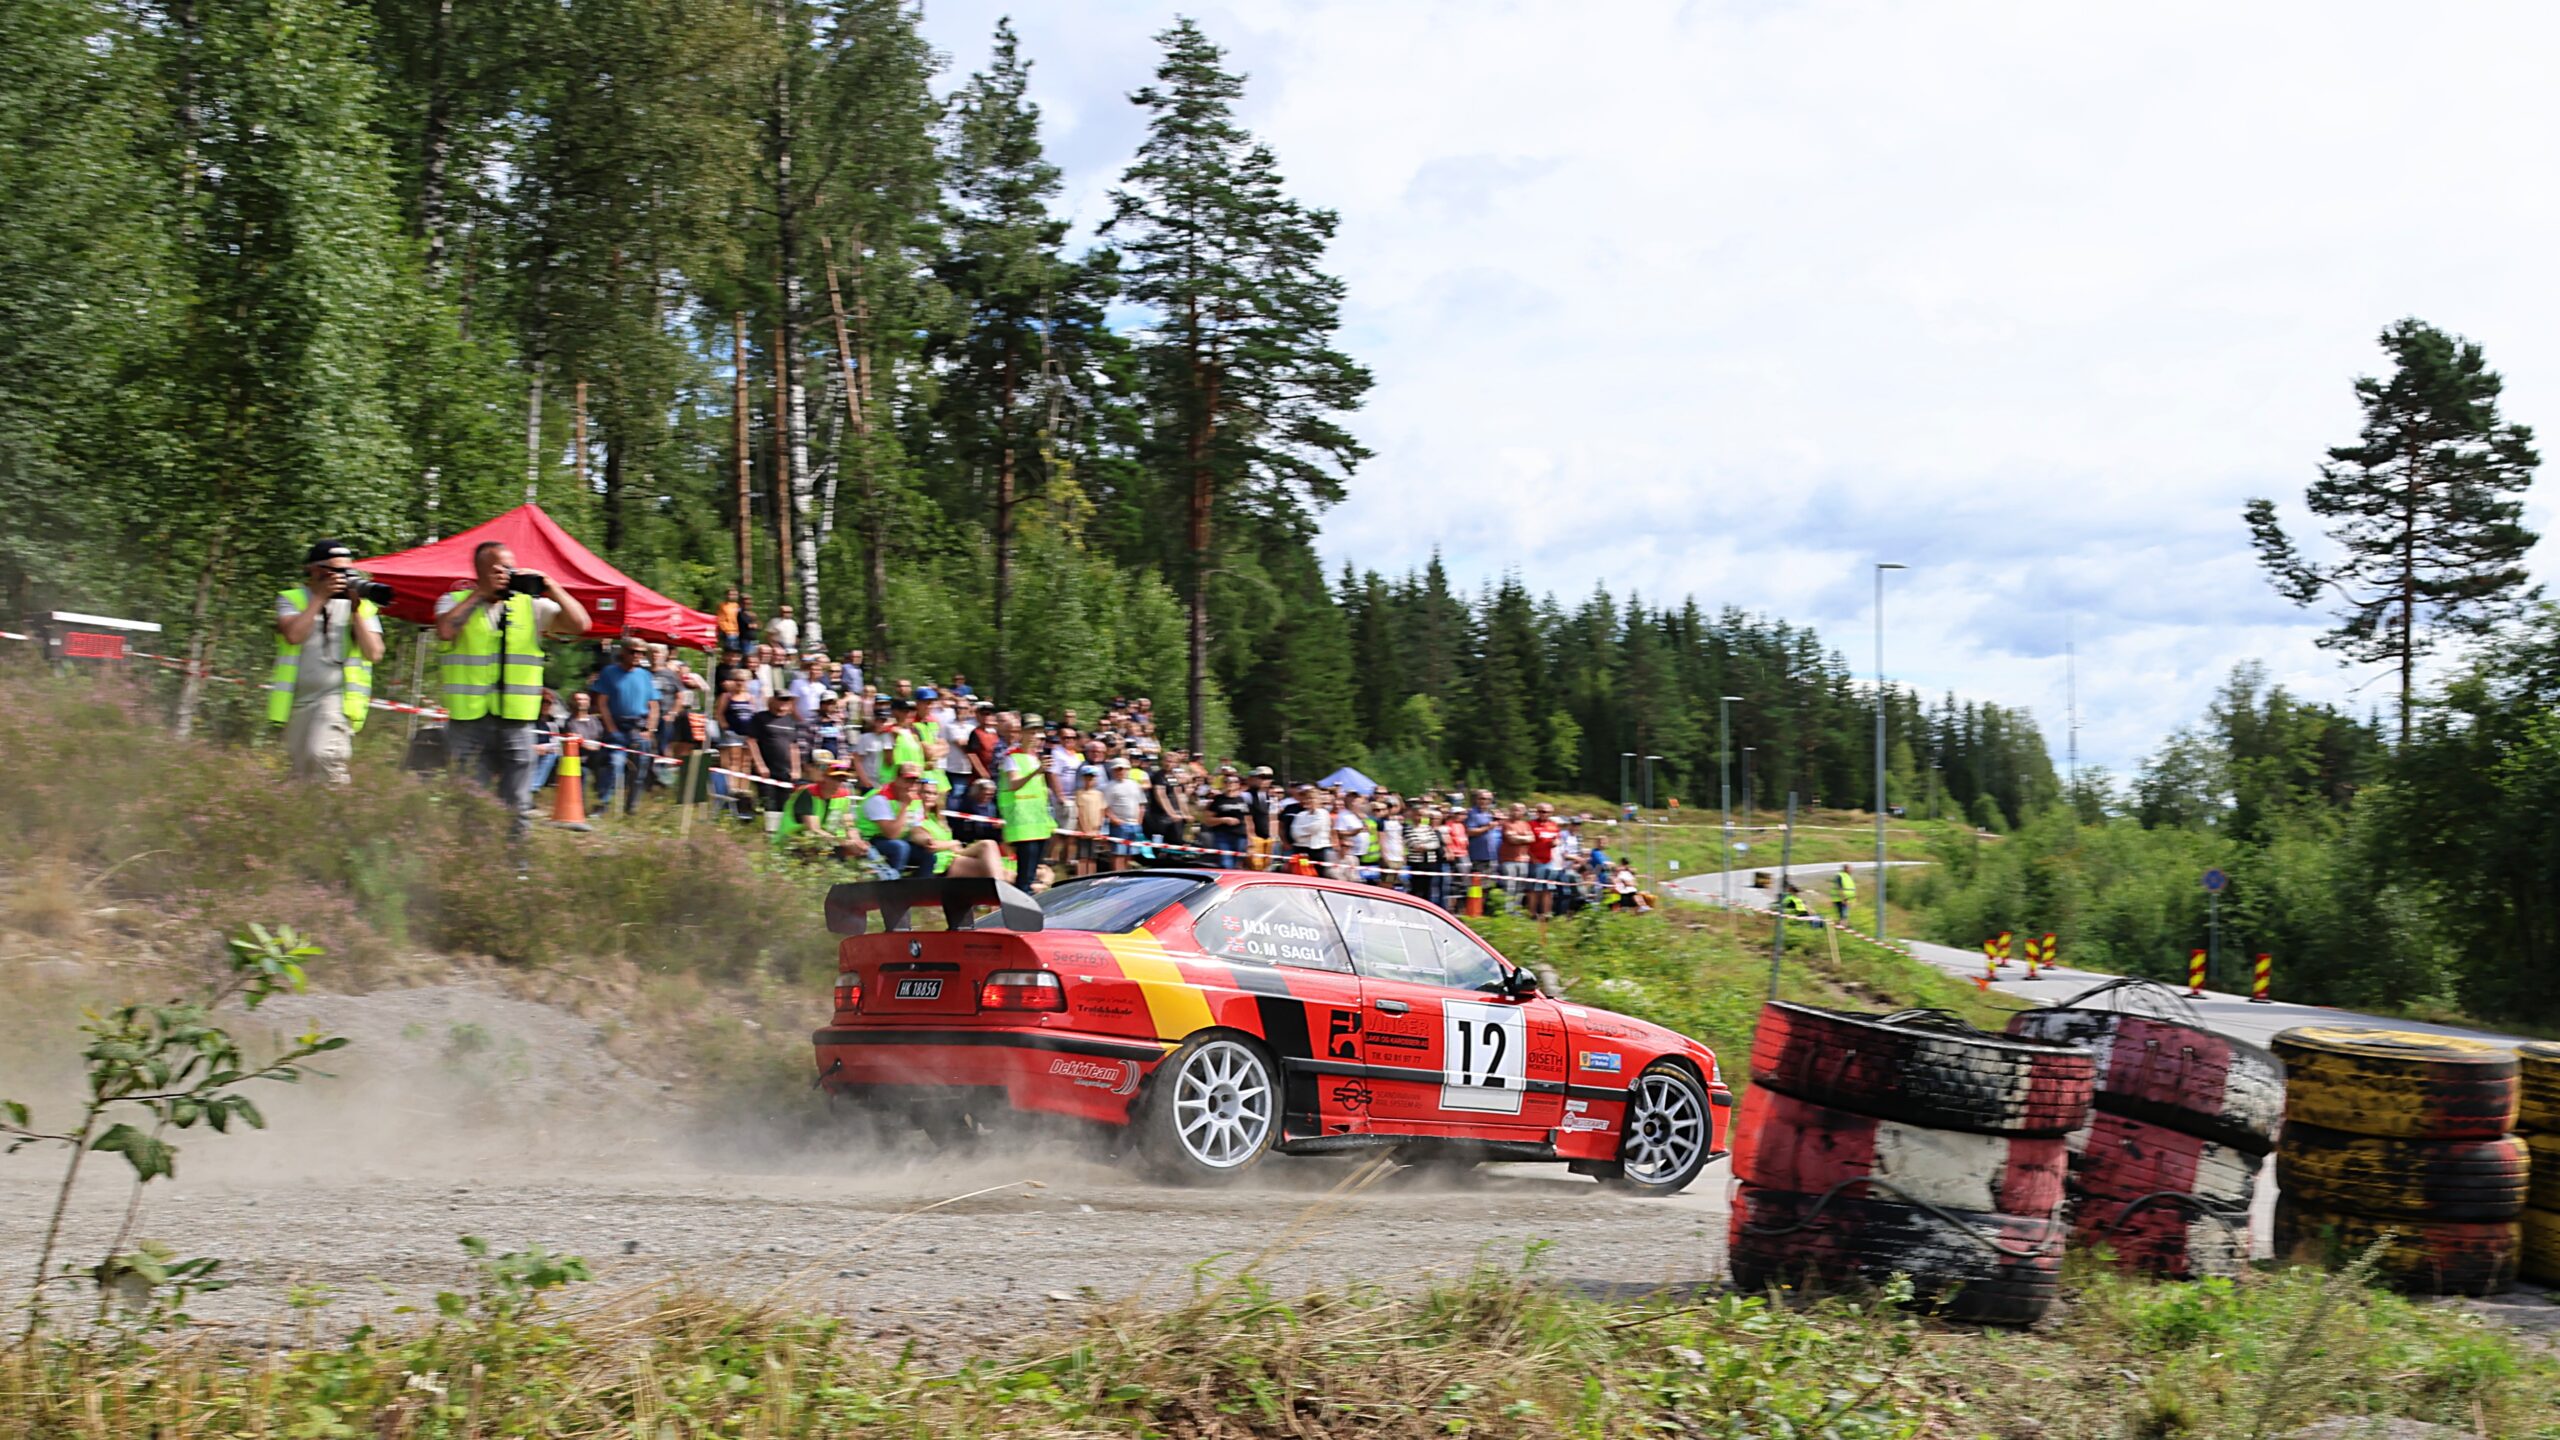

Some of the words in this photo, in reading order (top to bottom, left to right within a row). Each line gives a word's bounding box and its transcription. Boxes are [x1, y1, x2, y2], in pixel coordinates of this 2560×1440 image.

[1247, 940, 1278, 957] O.M
[1280, 944, 1325, 961] SAGLI
[912, 981, 938, 997] 18856
[1366, 1014, 1430, 1037] VINGER
[1458, 1020, 1506, 1088] 12
[1528, 1051, 1563, 1067] ØISETH
[1049, 1059, 1120, 1081] DekkTeam
[1332, 1087, 1373, 1104] SRS
